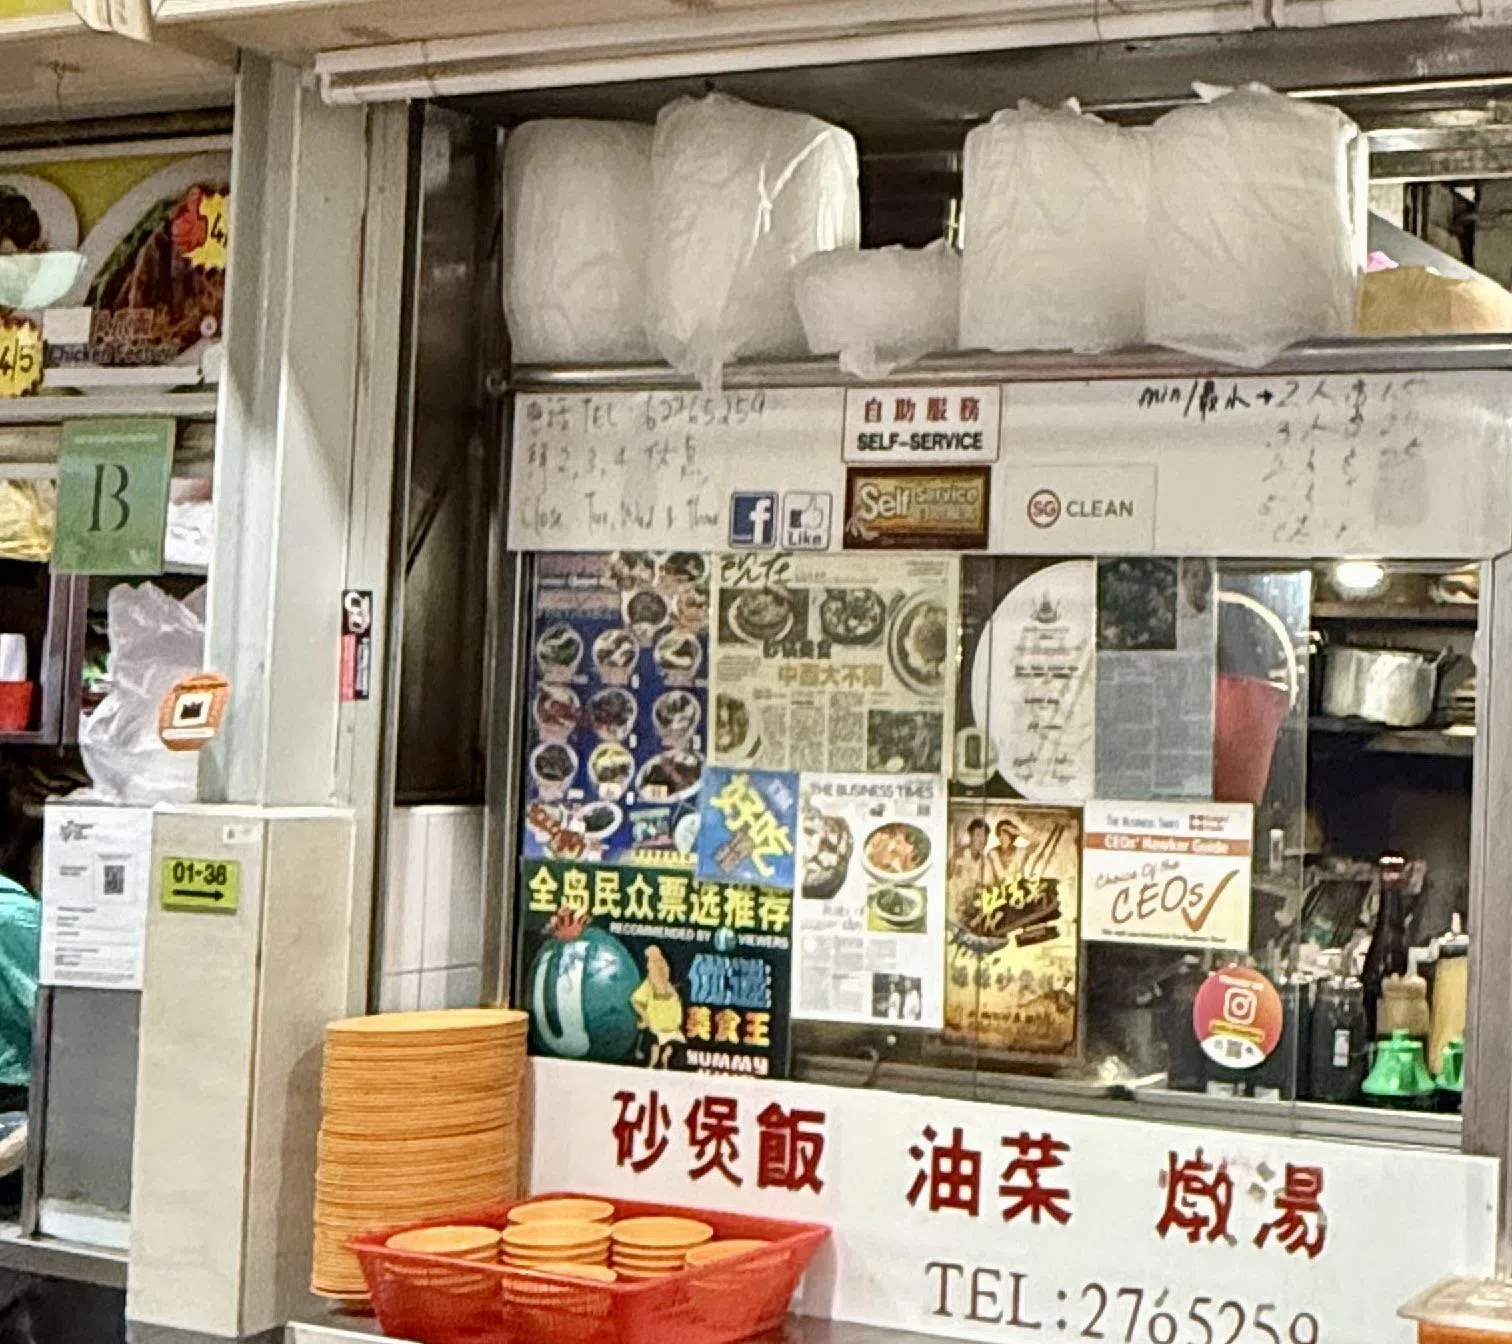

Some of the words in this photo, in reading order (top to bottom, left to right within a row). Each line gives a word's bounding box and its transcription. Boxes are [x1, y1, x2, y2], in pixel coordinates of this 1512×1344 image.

[864, 396, 980, 424] 自助服務
[857, 431, 983, 453] SELF-SERVICE
[87, 464, 131, 532] B
[859, 483, 912, 521] Self
[1031, 496, 1057, 519] SG
[1066, 499, 1134, 519] CLEAN
[788, 529, 822, 547] Like
[810, 782, 832, 798] THE
[836, 783, 895, 799] BUSINESS
[897, 783, 935, 800] TIMES
[173, 860, 228, 886] 01-38
[1112, 874, 1205, 925] CEOs
[612, 1090, 828, 1195] 砂煲飯
[905, 1123, 1074, 1228] 油菜
